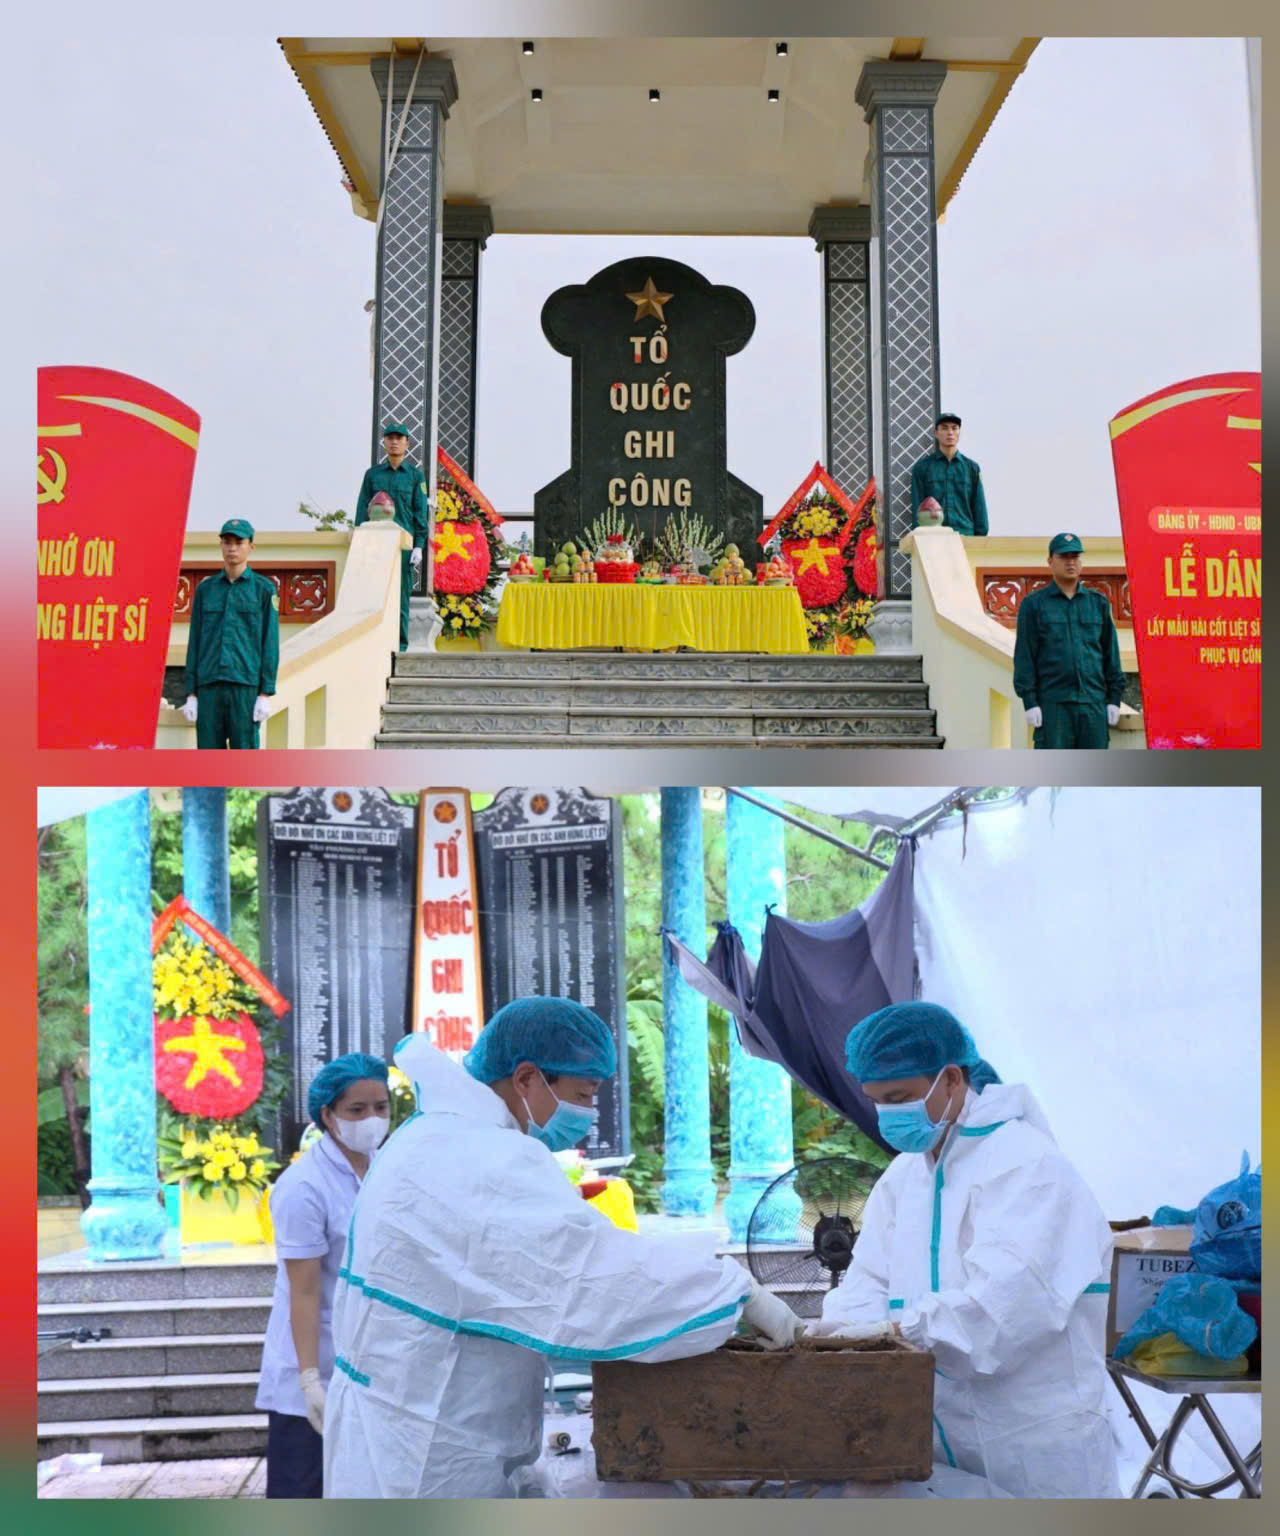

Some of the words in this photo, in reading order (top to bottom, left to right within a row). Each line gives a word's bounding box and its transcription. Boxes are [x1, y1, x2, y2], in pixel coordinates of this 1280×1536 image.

[630, 324, 668, 364] TỔ
[609, 371, 691, 414] QUỐC
[624, 430, 675, 459] GHI
[608, 472, 692, 507] CÔNG
[83, 536, 116, 577] ƠN
[1164, 542, 1198, 598] LỄ
[1205, 549, 1262, 598] DÂN
[72, 596, 120, 650] LIỆT
[123, 597, 150, 642] SĨ
[434, 828, 462, 878] TỔ
[423, 890, 473, 940] QUỐC
[431, 958, 463, 994] GHI
